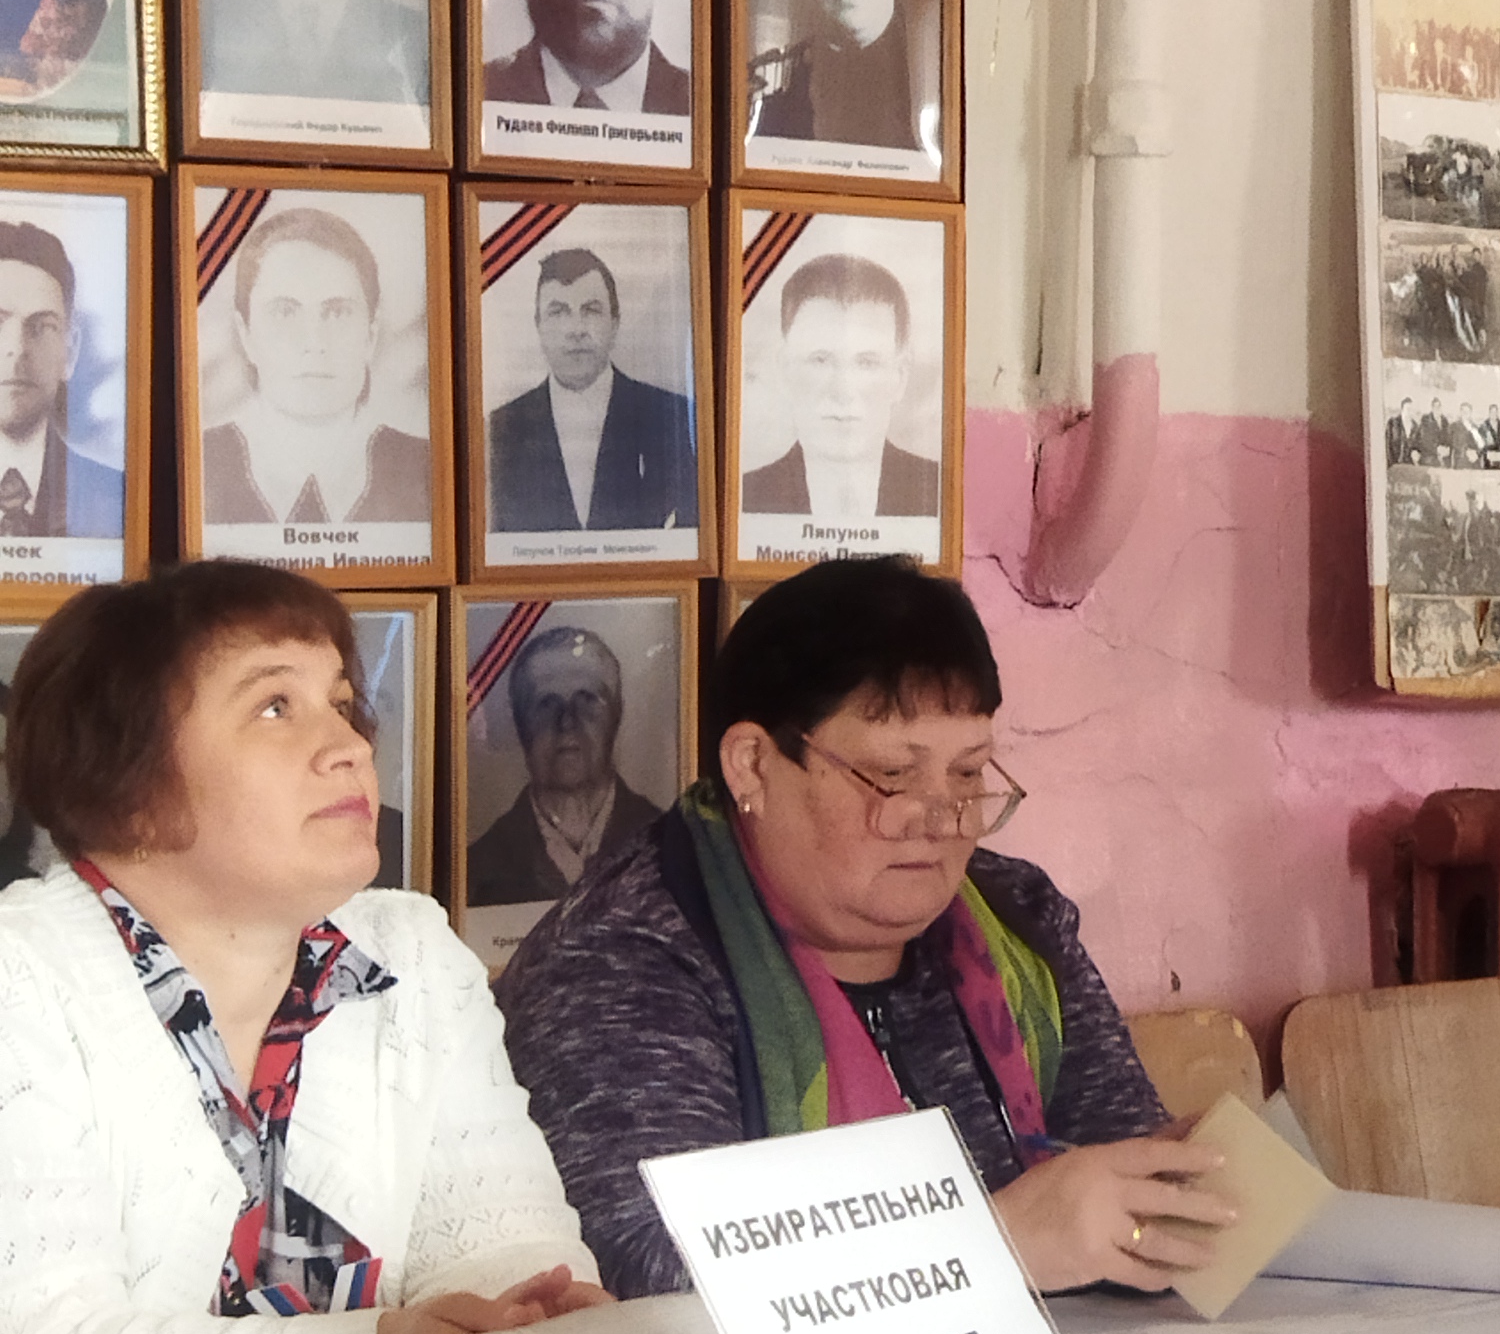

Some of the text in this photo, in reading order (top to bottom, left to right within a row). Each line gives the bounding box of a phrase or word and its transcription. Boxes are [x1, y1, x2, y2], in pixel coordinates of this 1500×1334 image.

[283, 527, 359, 545] Вовчек
[801, 523, 881, 543] Ляпунов
[702, 1175, 965, 1259] ИЗБИРАТЕЛЬНАЯ
[770, 1257, 972, 1332] УЧАСТКОВАЯ
